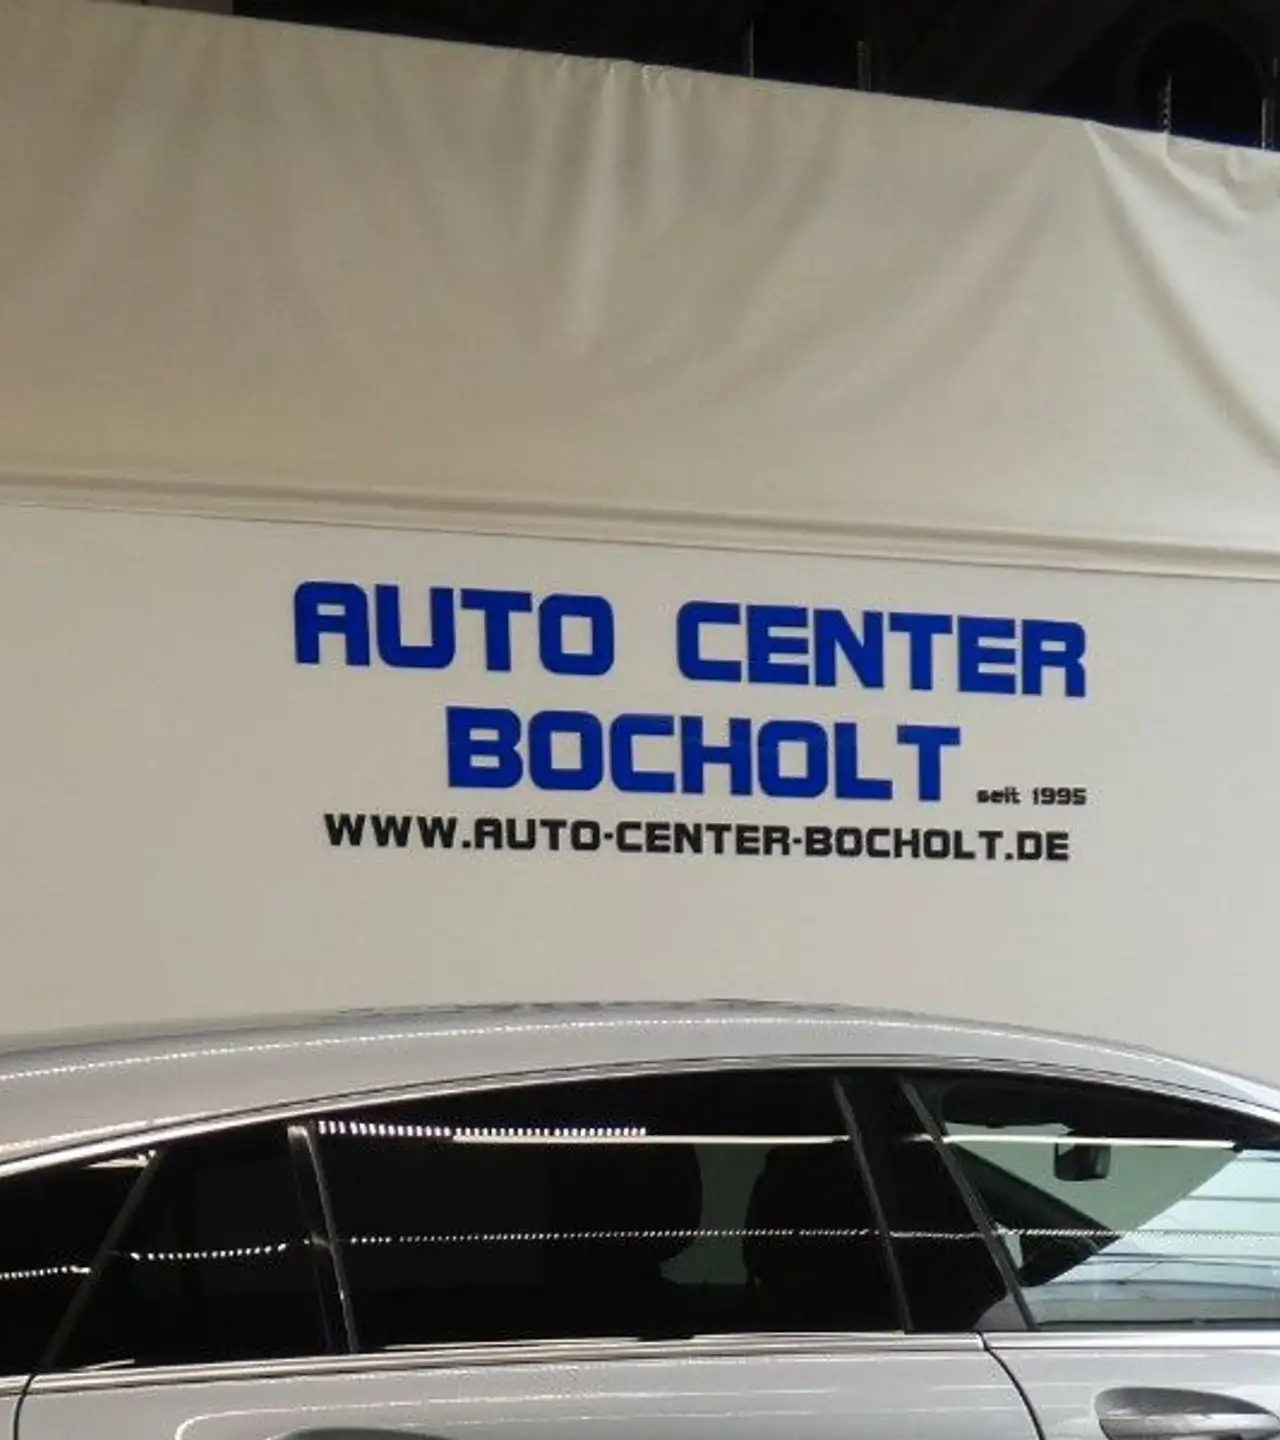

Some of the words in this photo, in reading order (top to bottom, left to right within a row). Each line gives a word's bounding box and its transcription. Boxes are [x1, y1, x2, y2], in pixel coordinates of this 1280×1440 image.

[295, 581, 614, 677] AUTO
[677, 601, 1087, 697] CENTER
[446, 707, 962, 803] BOCHOLT
[976, 786, 1021, 805] seit
[1032, 786, 1087, 806] 1995
[323, 813, 1070, 861] WWW.AUTO-CENTER-BOCHOLT.DE
